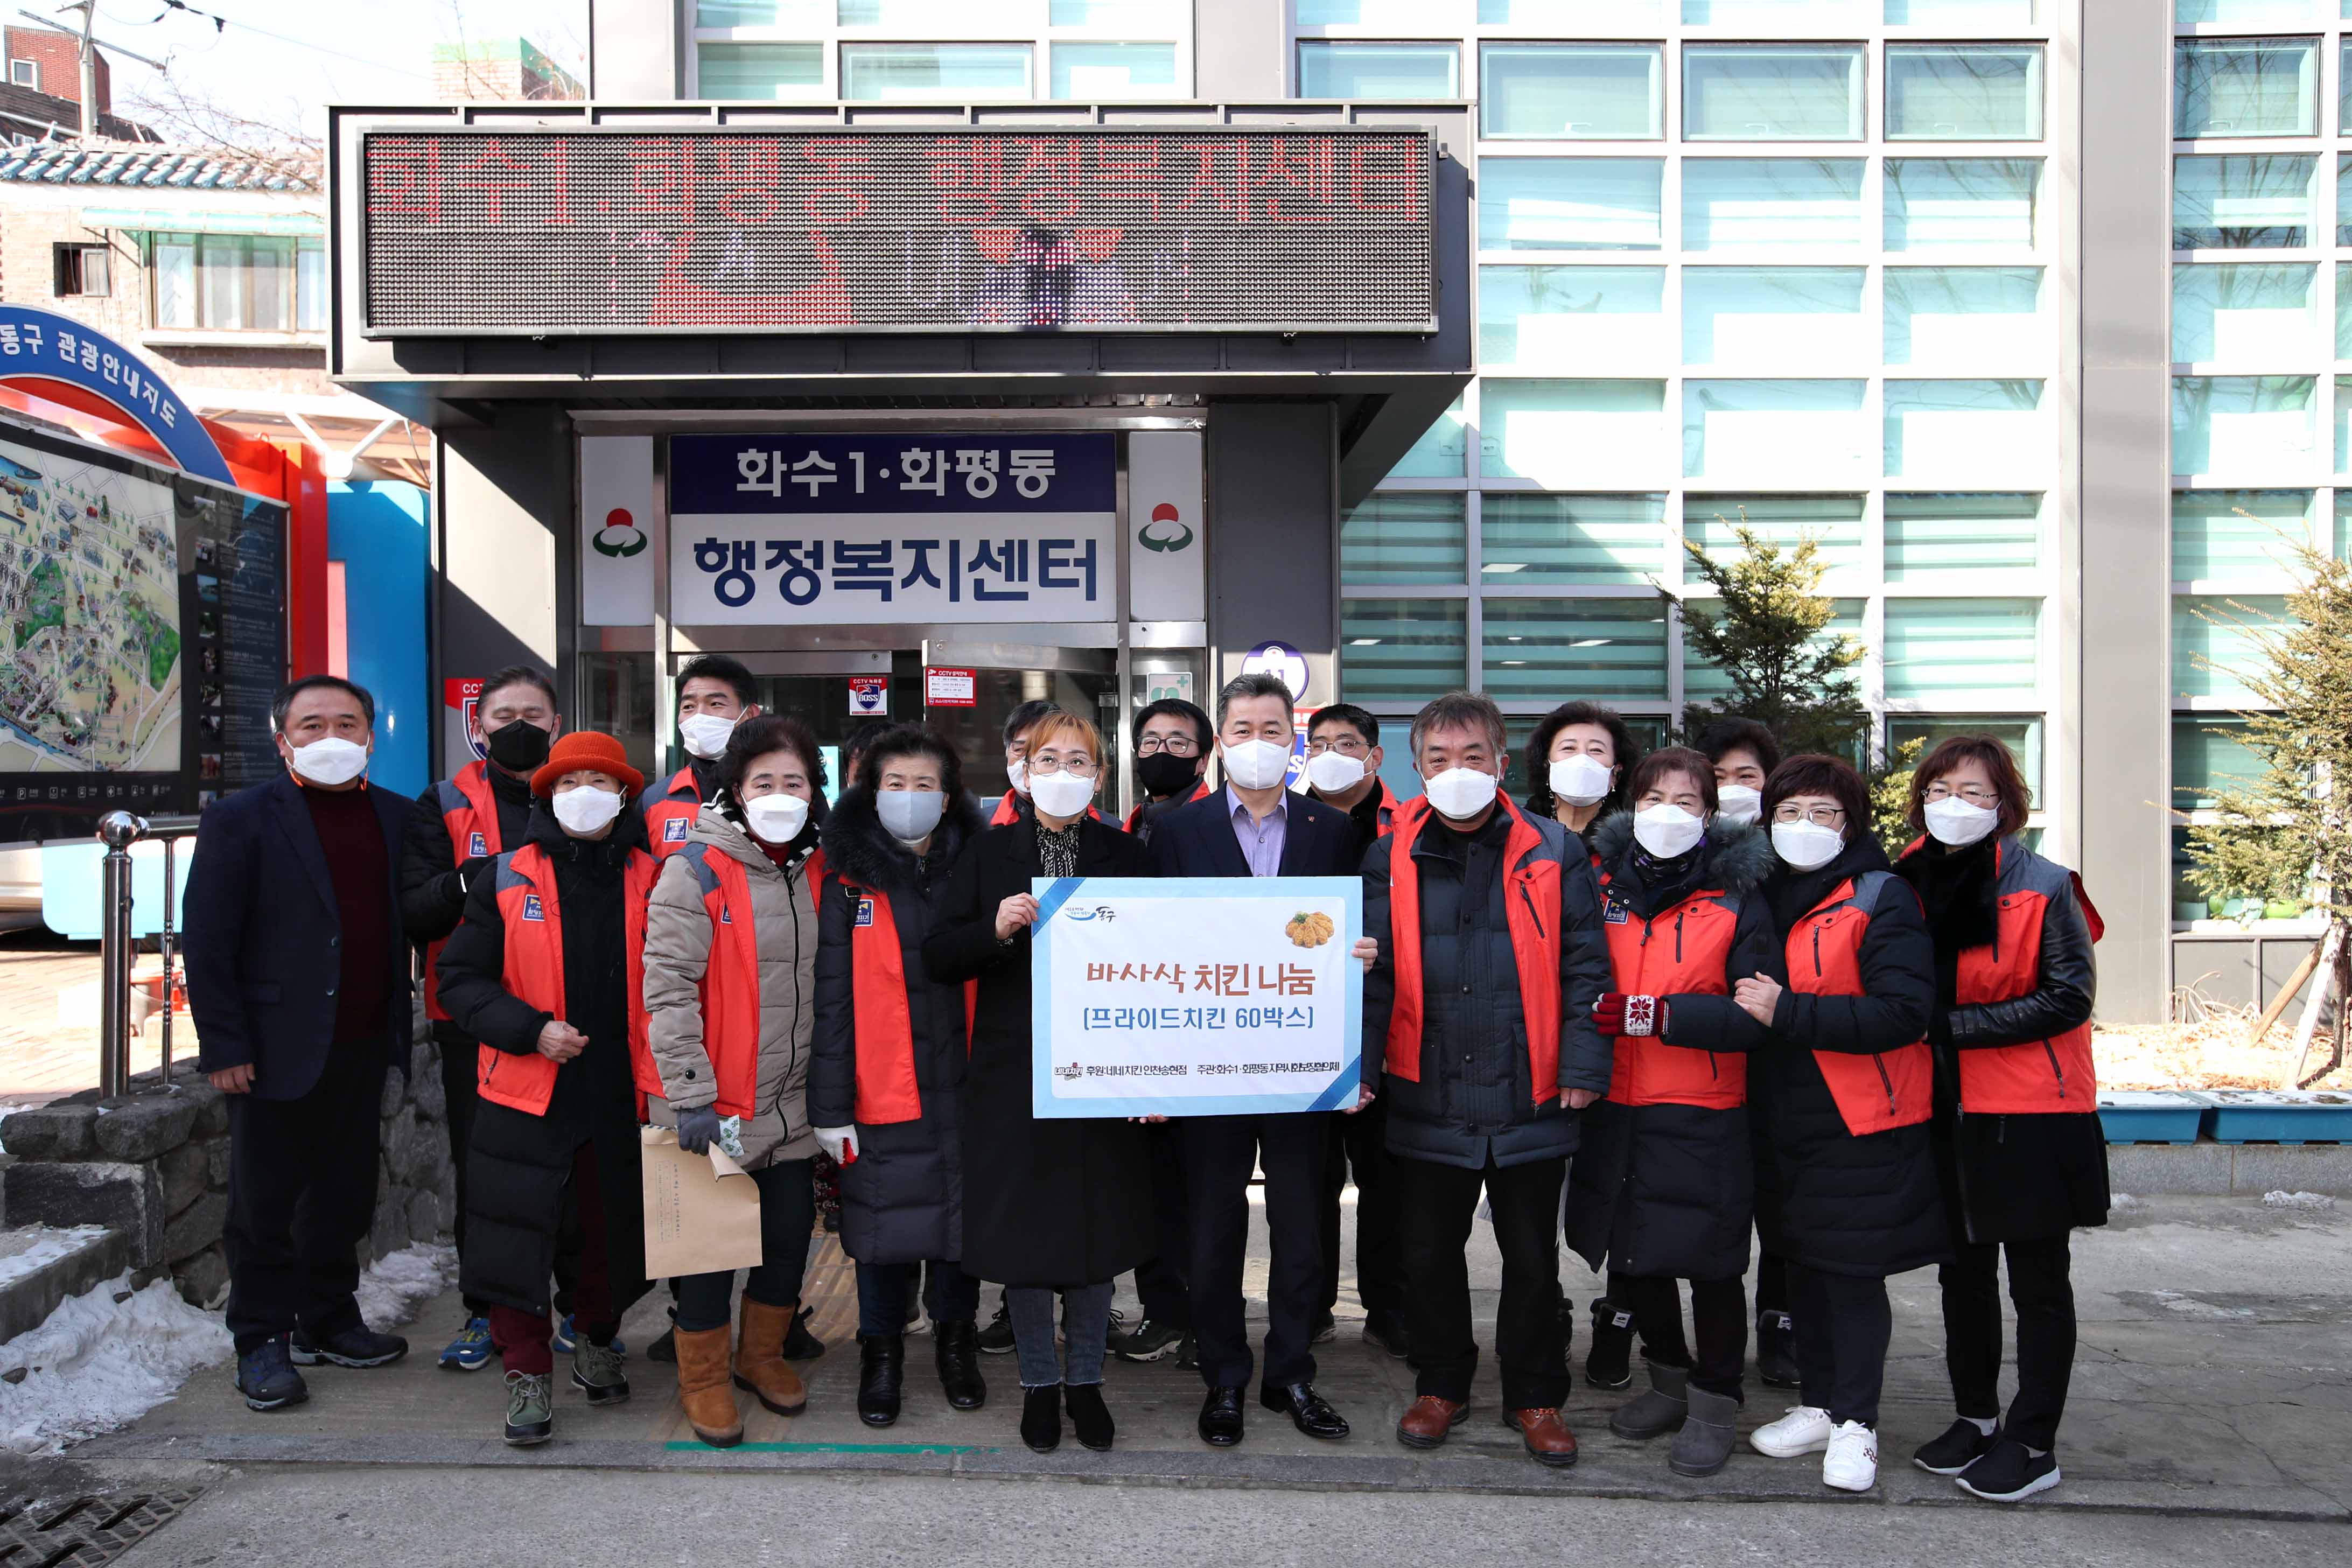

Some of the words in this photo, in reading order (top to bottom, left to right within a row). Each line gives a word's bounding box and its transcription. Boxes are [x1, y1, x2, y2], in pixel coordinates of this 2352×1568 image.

[923, 138, 1417, 222] 행정복지센터
[0, 324, 44, 355] 동구
[57, 331, 177, 429] 관광안내지도
[693, 536, 1097, 608] 행정복지센터
[859, 694, 878, 702] BOSS
[1095, 906, 1116, 923] 동구
[1087, 963, 1186, 993] 바사삭
[1194, 963, 1250, 996] 치킨
[1258, 963, 1316, 996] 나눔
